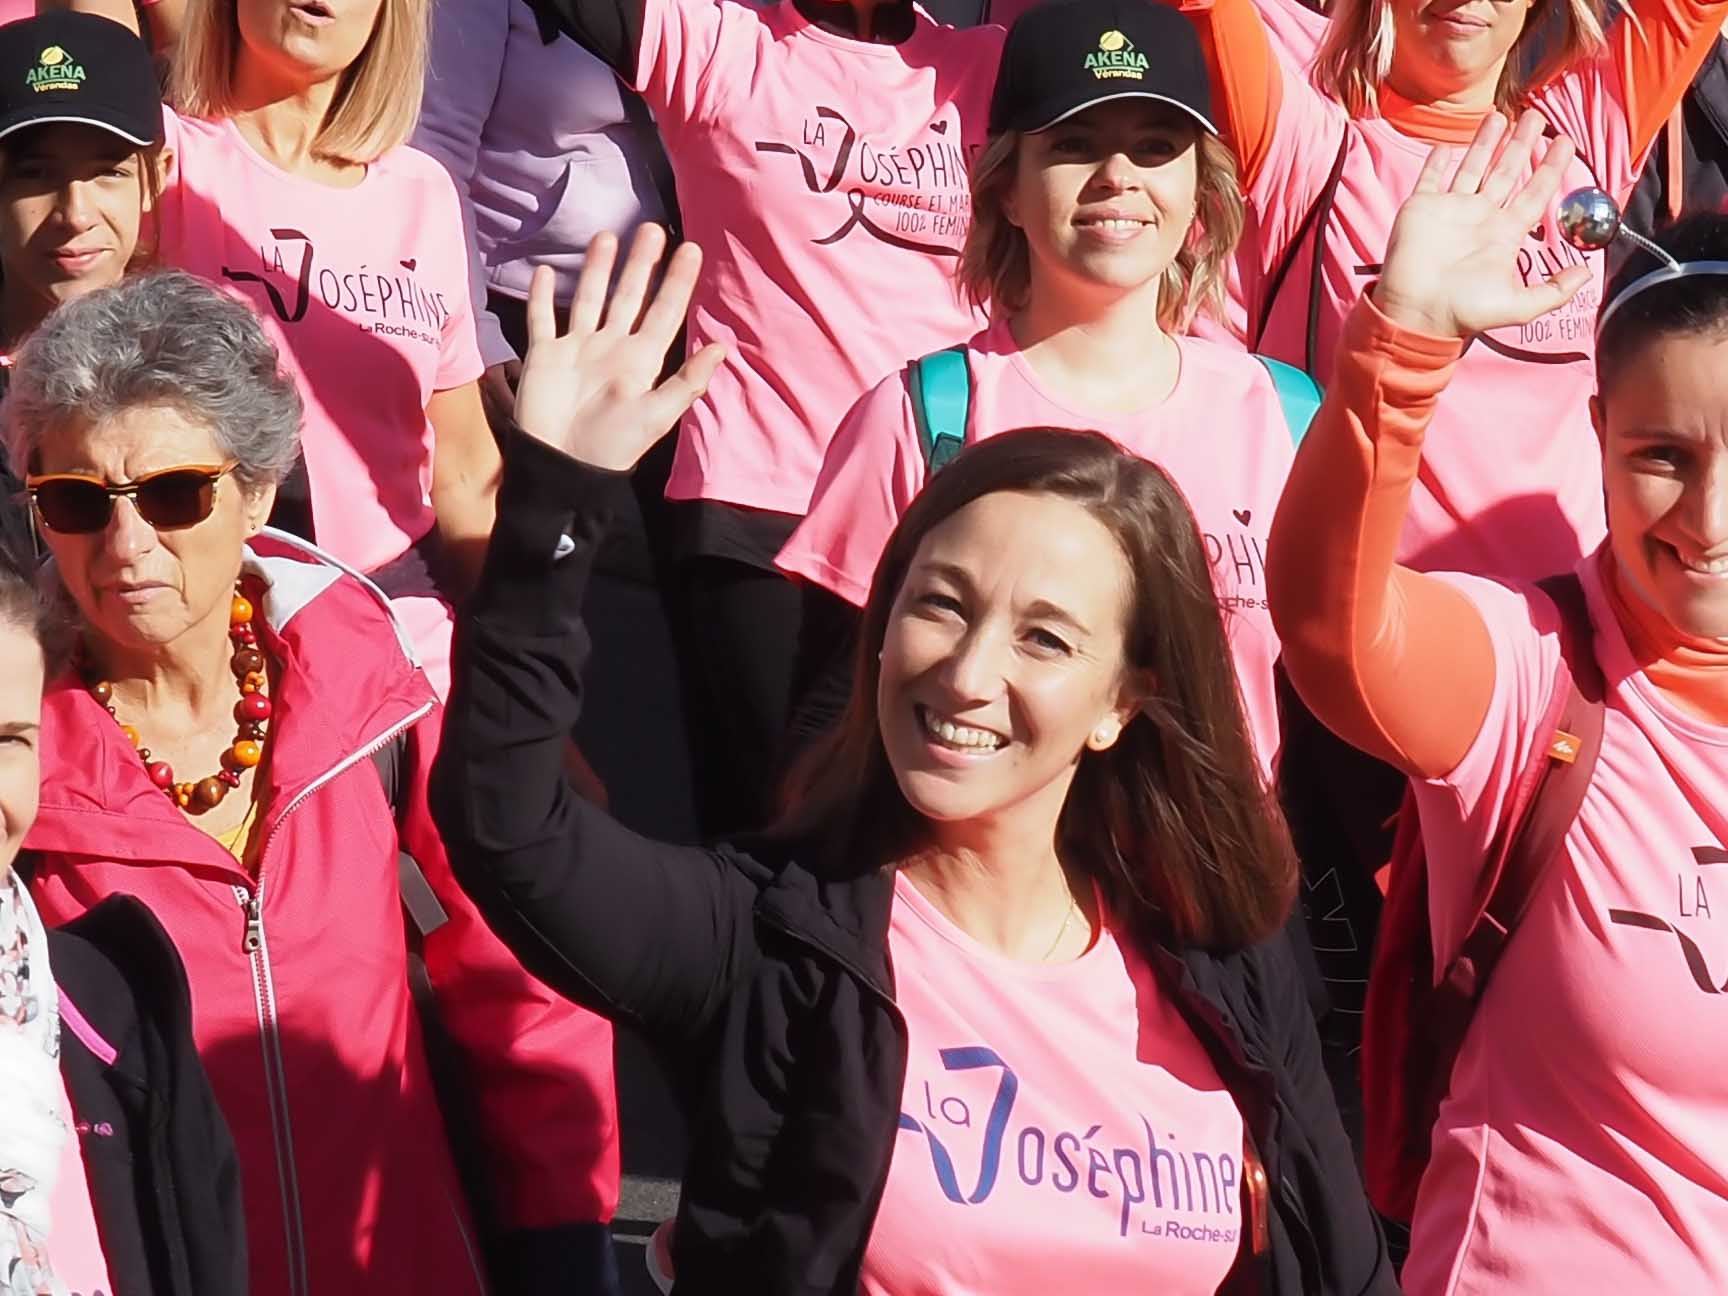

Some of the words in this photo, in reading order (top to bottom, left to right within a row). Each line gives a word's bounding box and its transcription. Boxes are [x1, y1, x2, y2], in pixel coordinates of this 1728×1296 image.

[1083, 50, 1150, 70] AKENA
[25, 63, 87, 85] AKENA
[803, 119, 826, 147] LA
[873, 191, 922, 210] COURSE
[895, 211, 928, 233] 100%
[260, 245, 286, 274] LA
[1677, 872, 1712, 920] LA
[924, 1079, 971, 1128] la
[922, 1045, 1237, 1237] Joséphine
[1141, 1220, 1162, 1236] La
